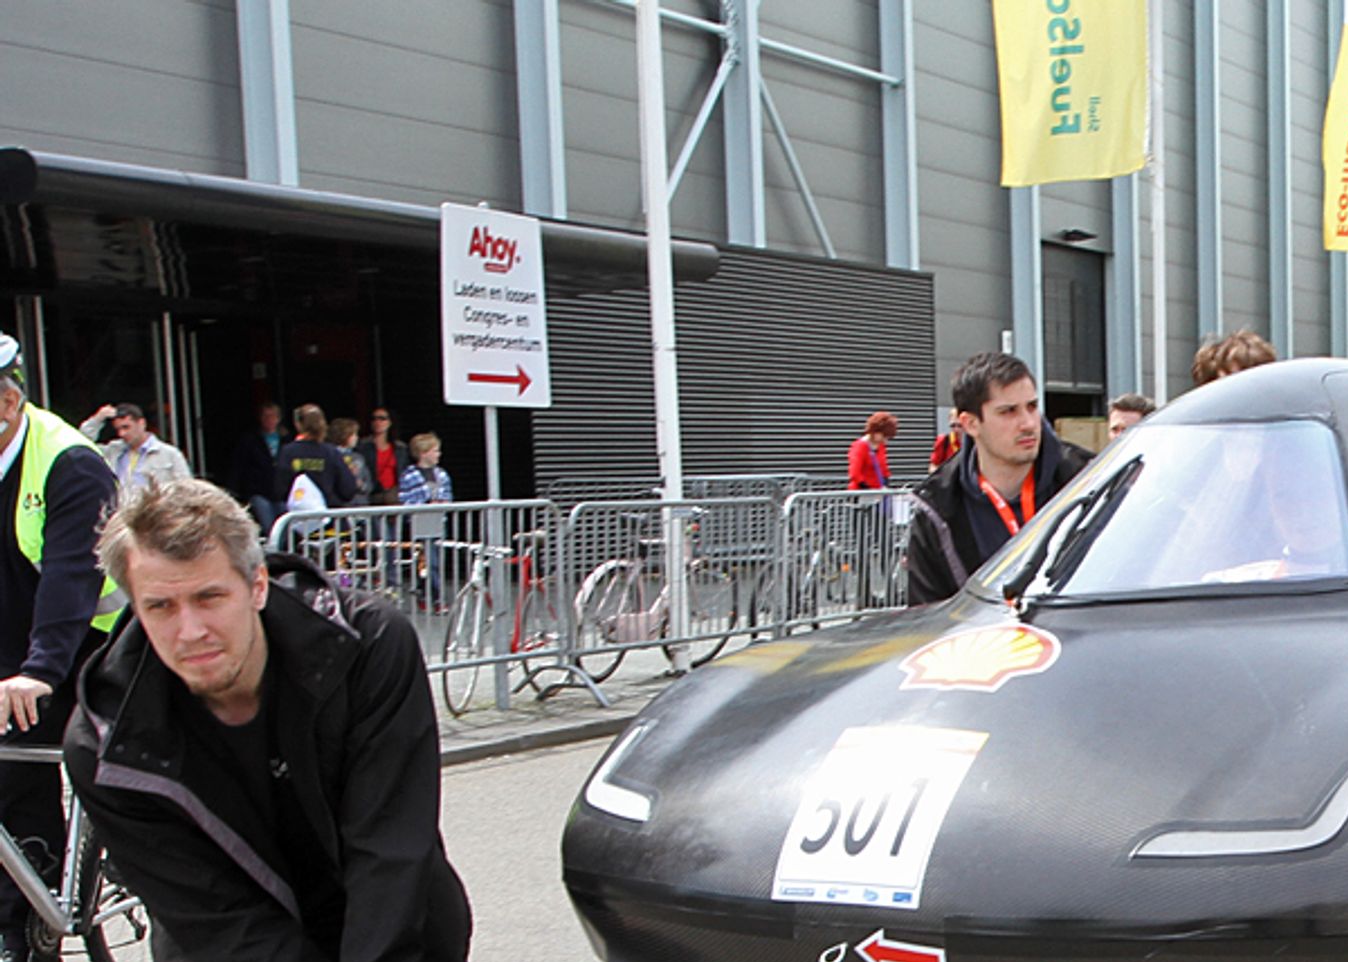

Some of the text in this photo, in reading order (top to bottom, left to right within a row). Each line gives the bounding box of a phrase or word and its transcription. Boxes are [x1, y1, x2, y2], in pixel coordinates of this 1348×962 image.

[454, 279, 486, 298] Laden
[489, 287, 502, 299] en
[464, 305, 530, 328] Congres- en
[800, 777, 930, 858] 501
